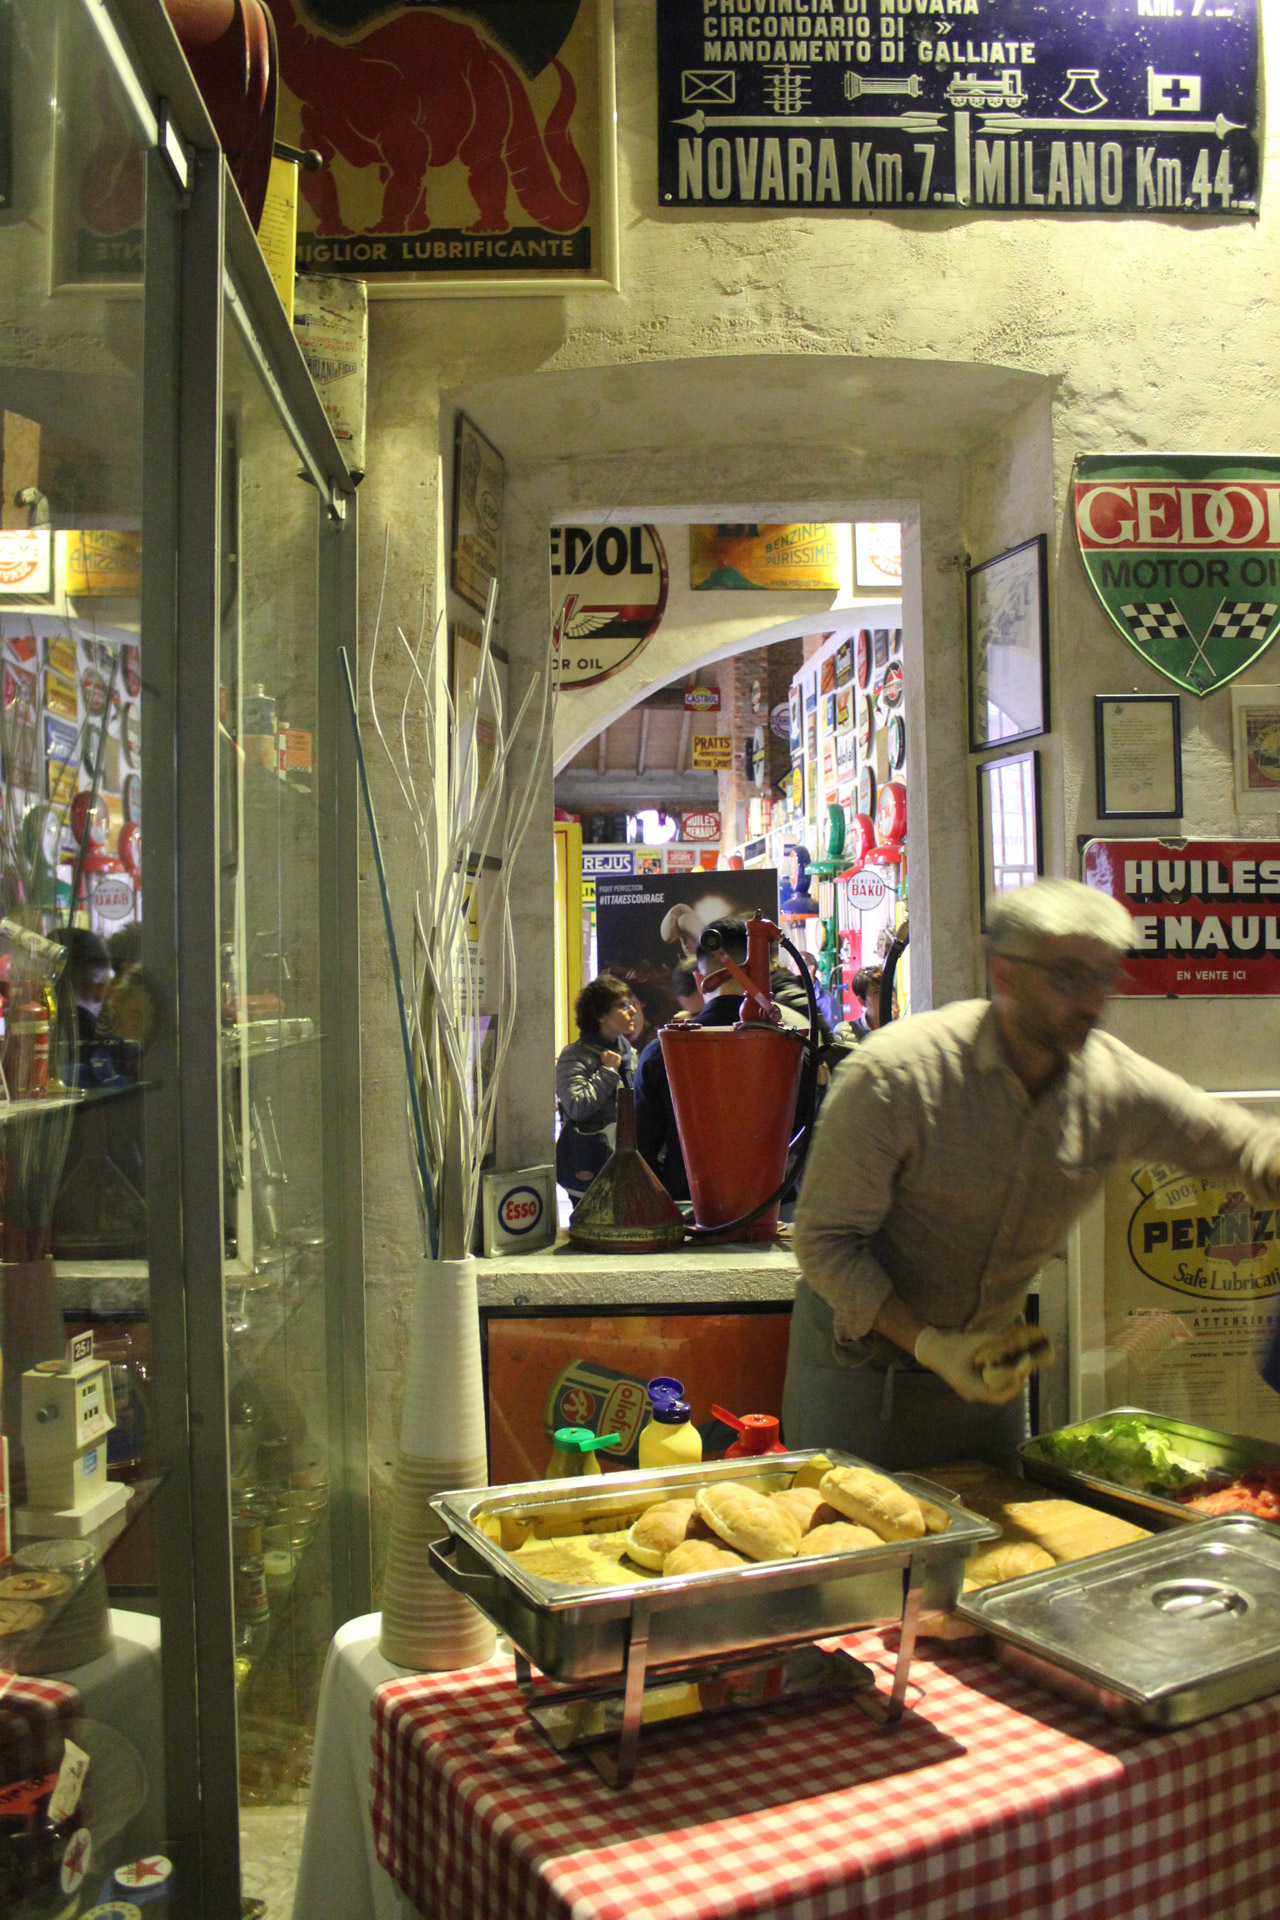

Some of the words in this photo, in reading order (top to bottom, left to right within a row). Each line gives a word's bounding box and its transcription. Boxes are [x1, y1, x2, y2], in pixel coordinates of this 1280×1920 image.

[704, 0, 833, 13] PROVINCIA
[843, 0, 867, 13] DI
[880, 0, 979, 14] NOVARA
[704, 17, 870, 38] CIRCONDARIO
[880, 18, 904, 38] DI
[704, 41, 871, 62] MANDAMENTO
[880, 42, 904, 62] DI
[918, 41, 1035, 63] GALLIATE
[678, 137, 841, 201] NOVARA
[975, 140, 1123, 206] MILANO
[402, 239, 574, 260] LUBRIFICANTE
[1102, 558, 1230, 588] MOTOR
[1240, 557, 1280, 587] OI
[577, 658, 603, 670] OIL
[686, 694, 718, 703] CASTROL
[694, 736, 729, 752] PRATTS
[687, 814, 715, 827] HUILES
[1125, 860, 1280, 894] HUILES
[600, 893, 664, 905] #ITTAKESCOURAGE
[852, 884, 882, 896] BAKU
[1177, 971, 1191, 980] EN
[1196, 970, 1228, 980] VENTE
[1233, 970, 1246, 980] ICI
[1173, 1263, 1207, 1289] Safe
